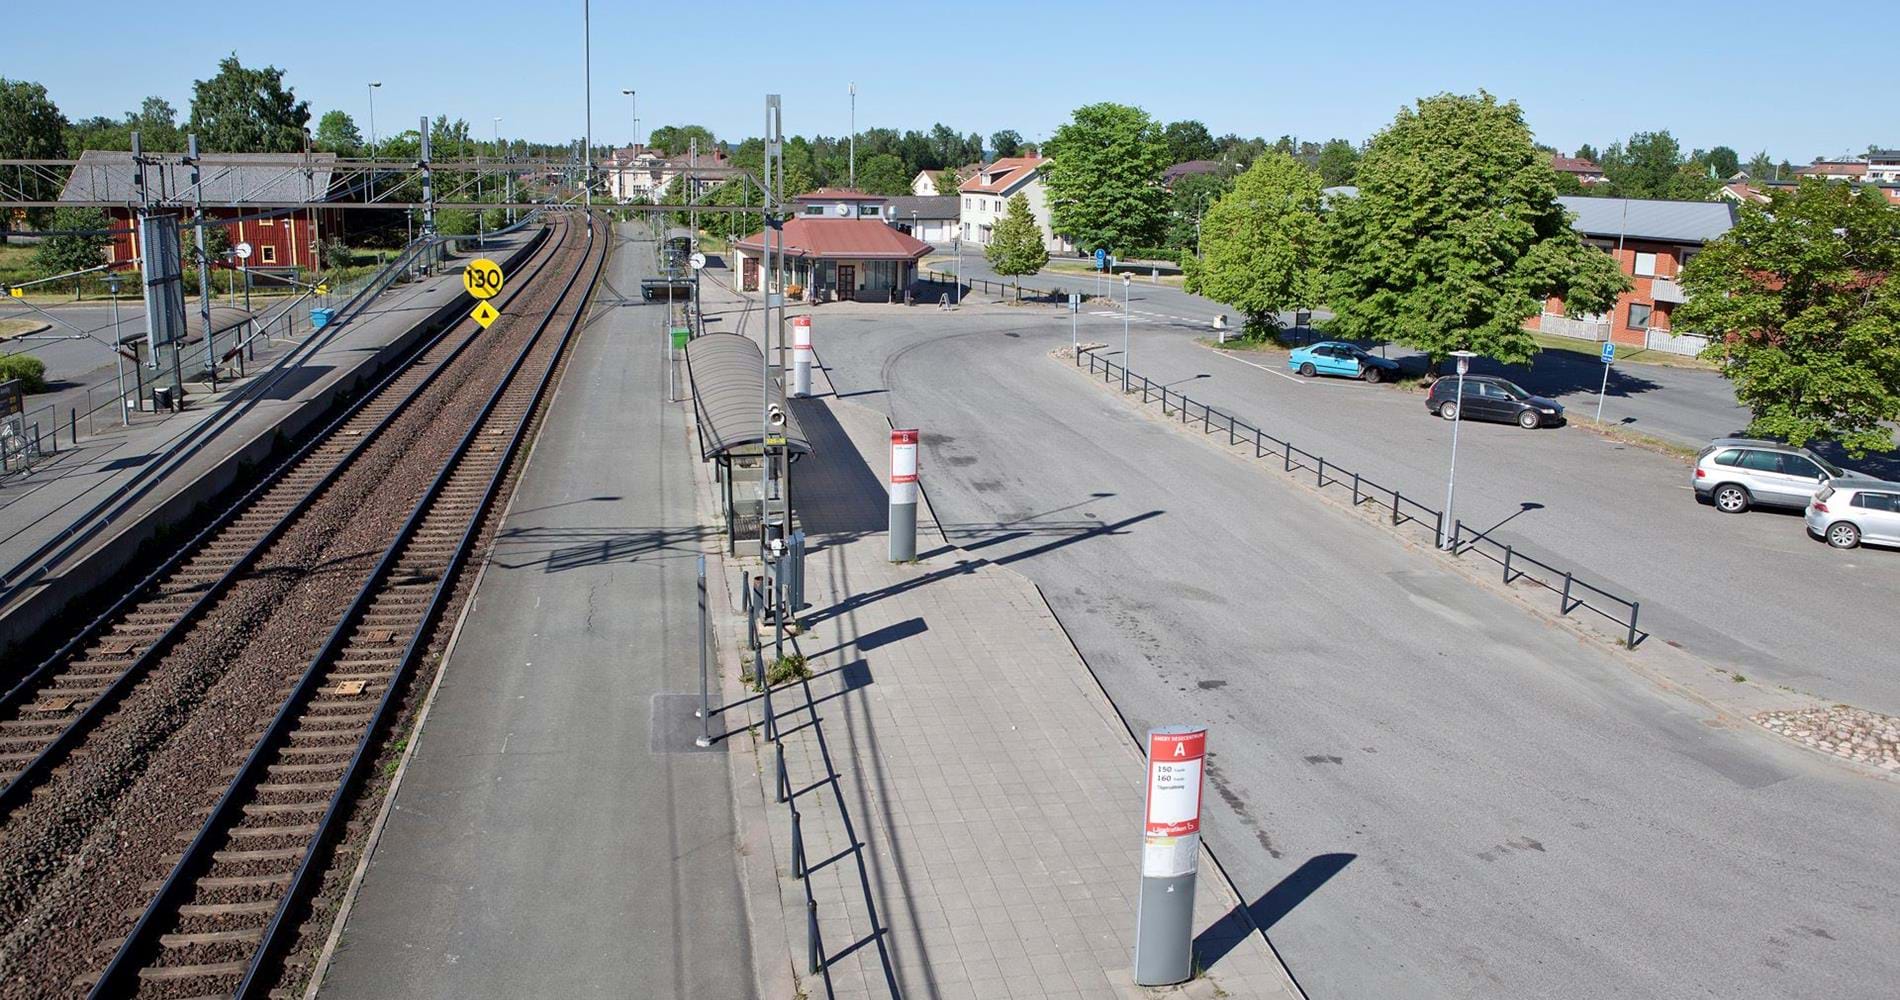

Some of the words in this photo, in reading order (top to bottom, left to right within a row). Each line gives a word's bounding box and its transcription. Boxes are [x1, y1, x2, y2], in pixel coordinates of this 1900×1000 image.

[466, 269, 500, 288] 130
[1606, 344, 1613, 356] P
[902, 433, 909, 442] B
[1174, 741, 1186, 757] A
[1157, 765, 1173, 773] 150
